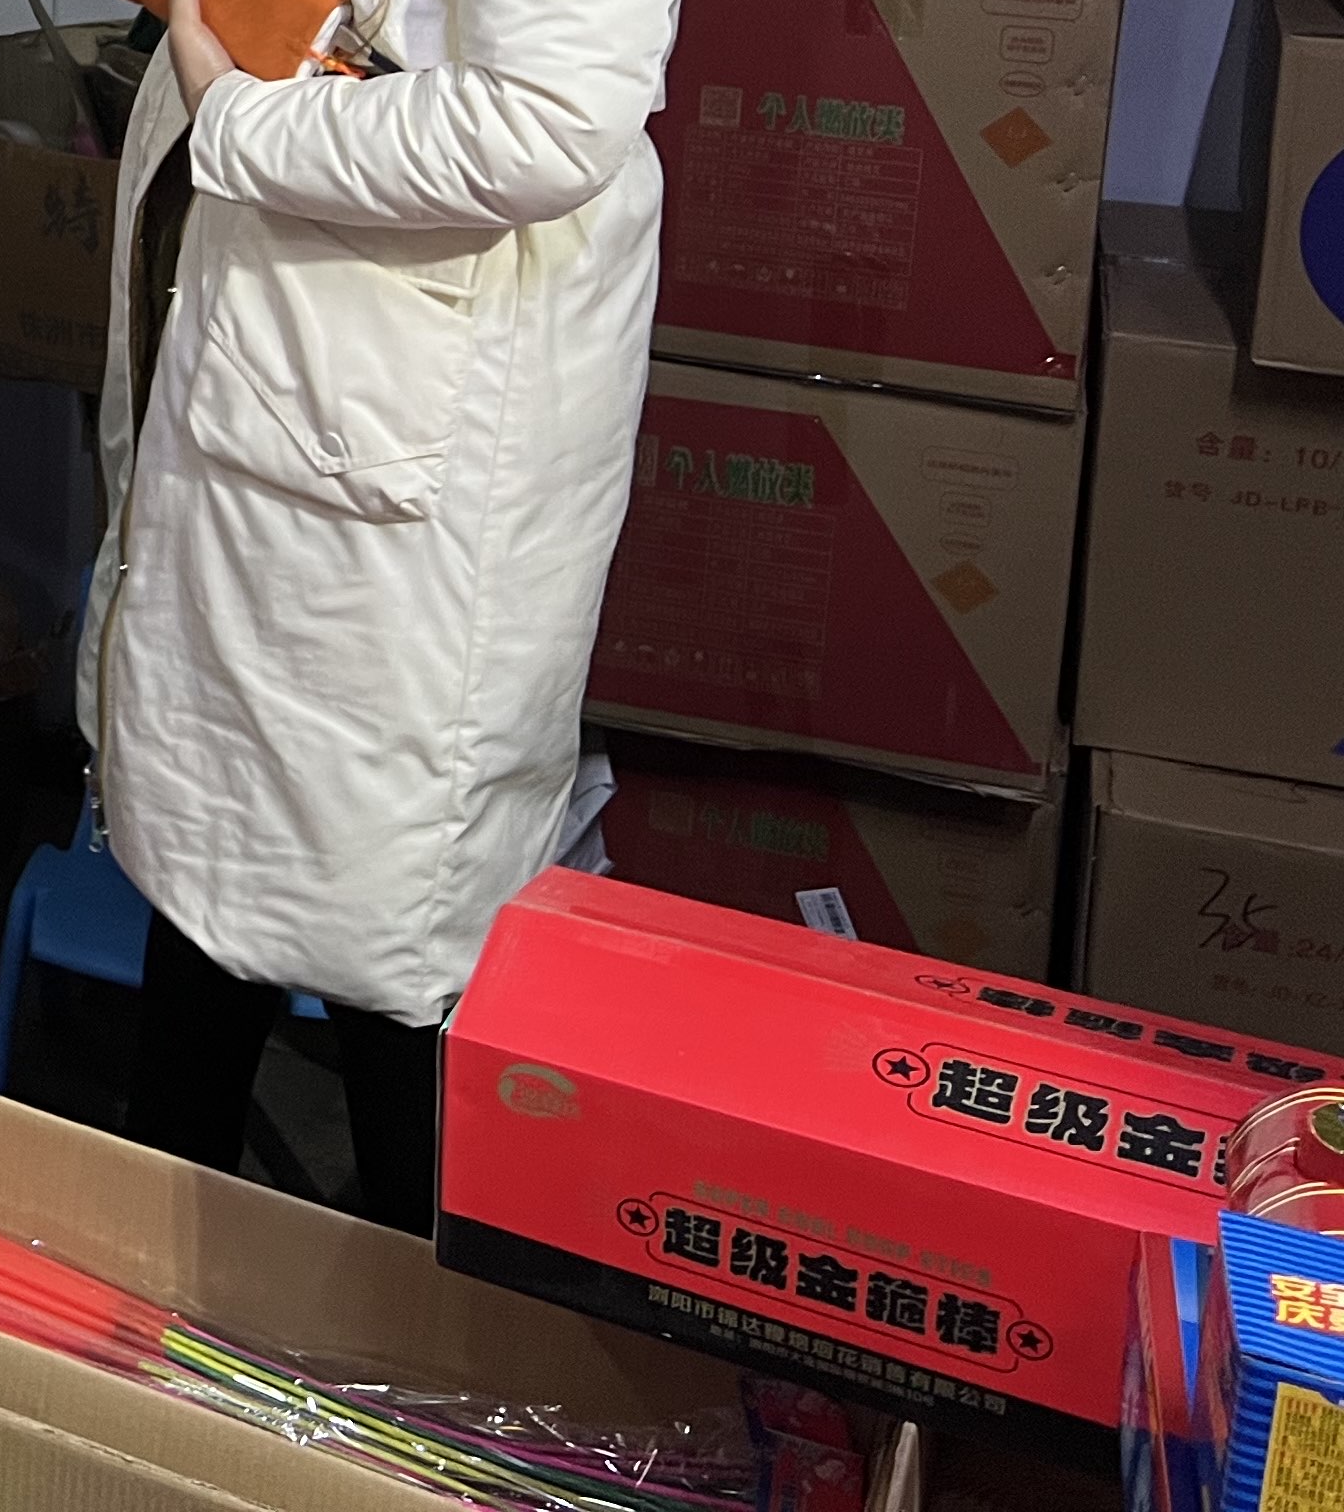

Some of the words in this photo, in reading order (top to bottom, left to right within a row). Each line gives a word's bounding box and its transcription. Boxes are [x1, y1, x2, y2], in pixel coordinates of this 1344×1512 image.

[933, 1058, 1227, 1186] 超级金
[661, 1207, 1002, 1356] 超级金箍棒
